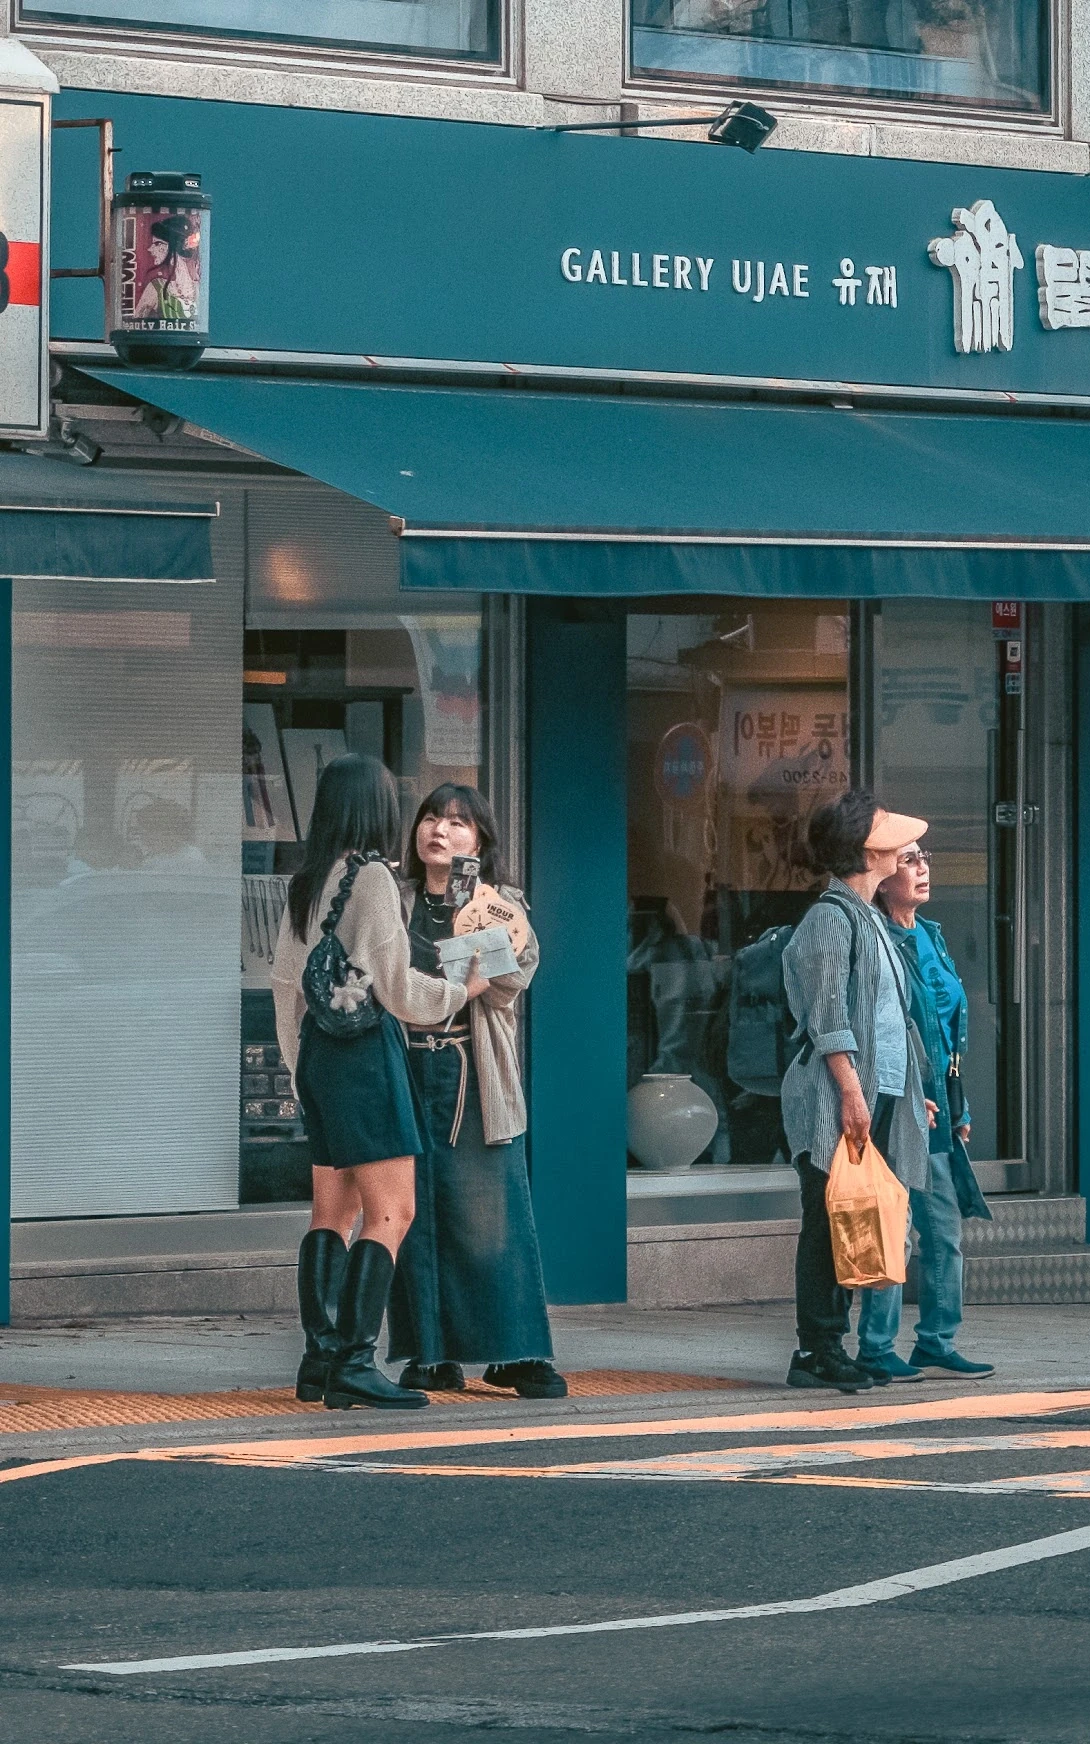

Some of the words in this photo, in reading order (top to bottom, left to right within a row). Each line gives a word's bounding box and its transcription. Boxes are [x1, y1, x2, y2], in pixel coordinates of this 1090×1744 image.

[561, 247, 714, 291] GALLERY
[732, 259, 810, 302] UJAE
[832, 257, 898, 308] 유재
[122, 320, 155, 331] eauty
[159, 319, 187, 331] Hair
